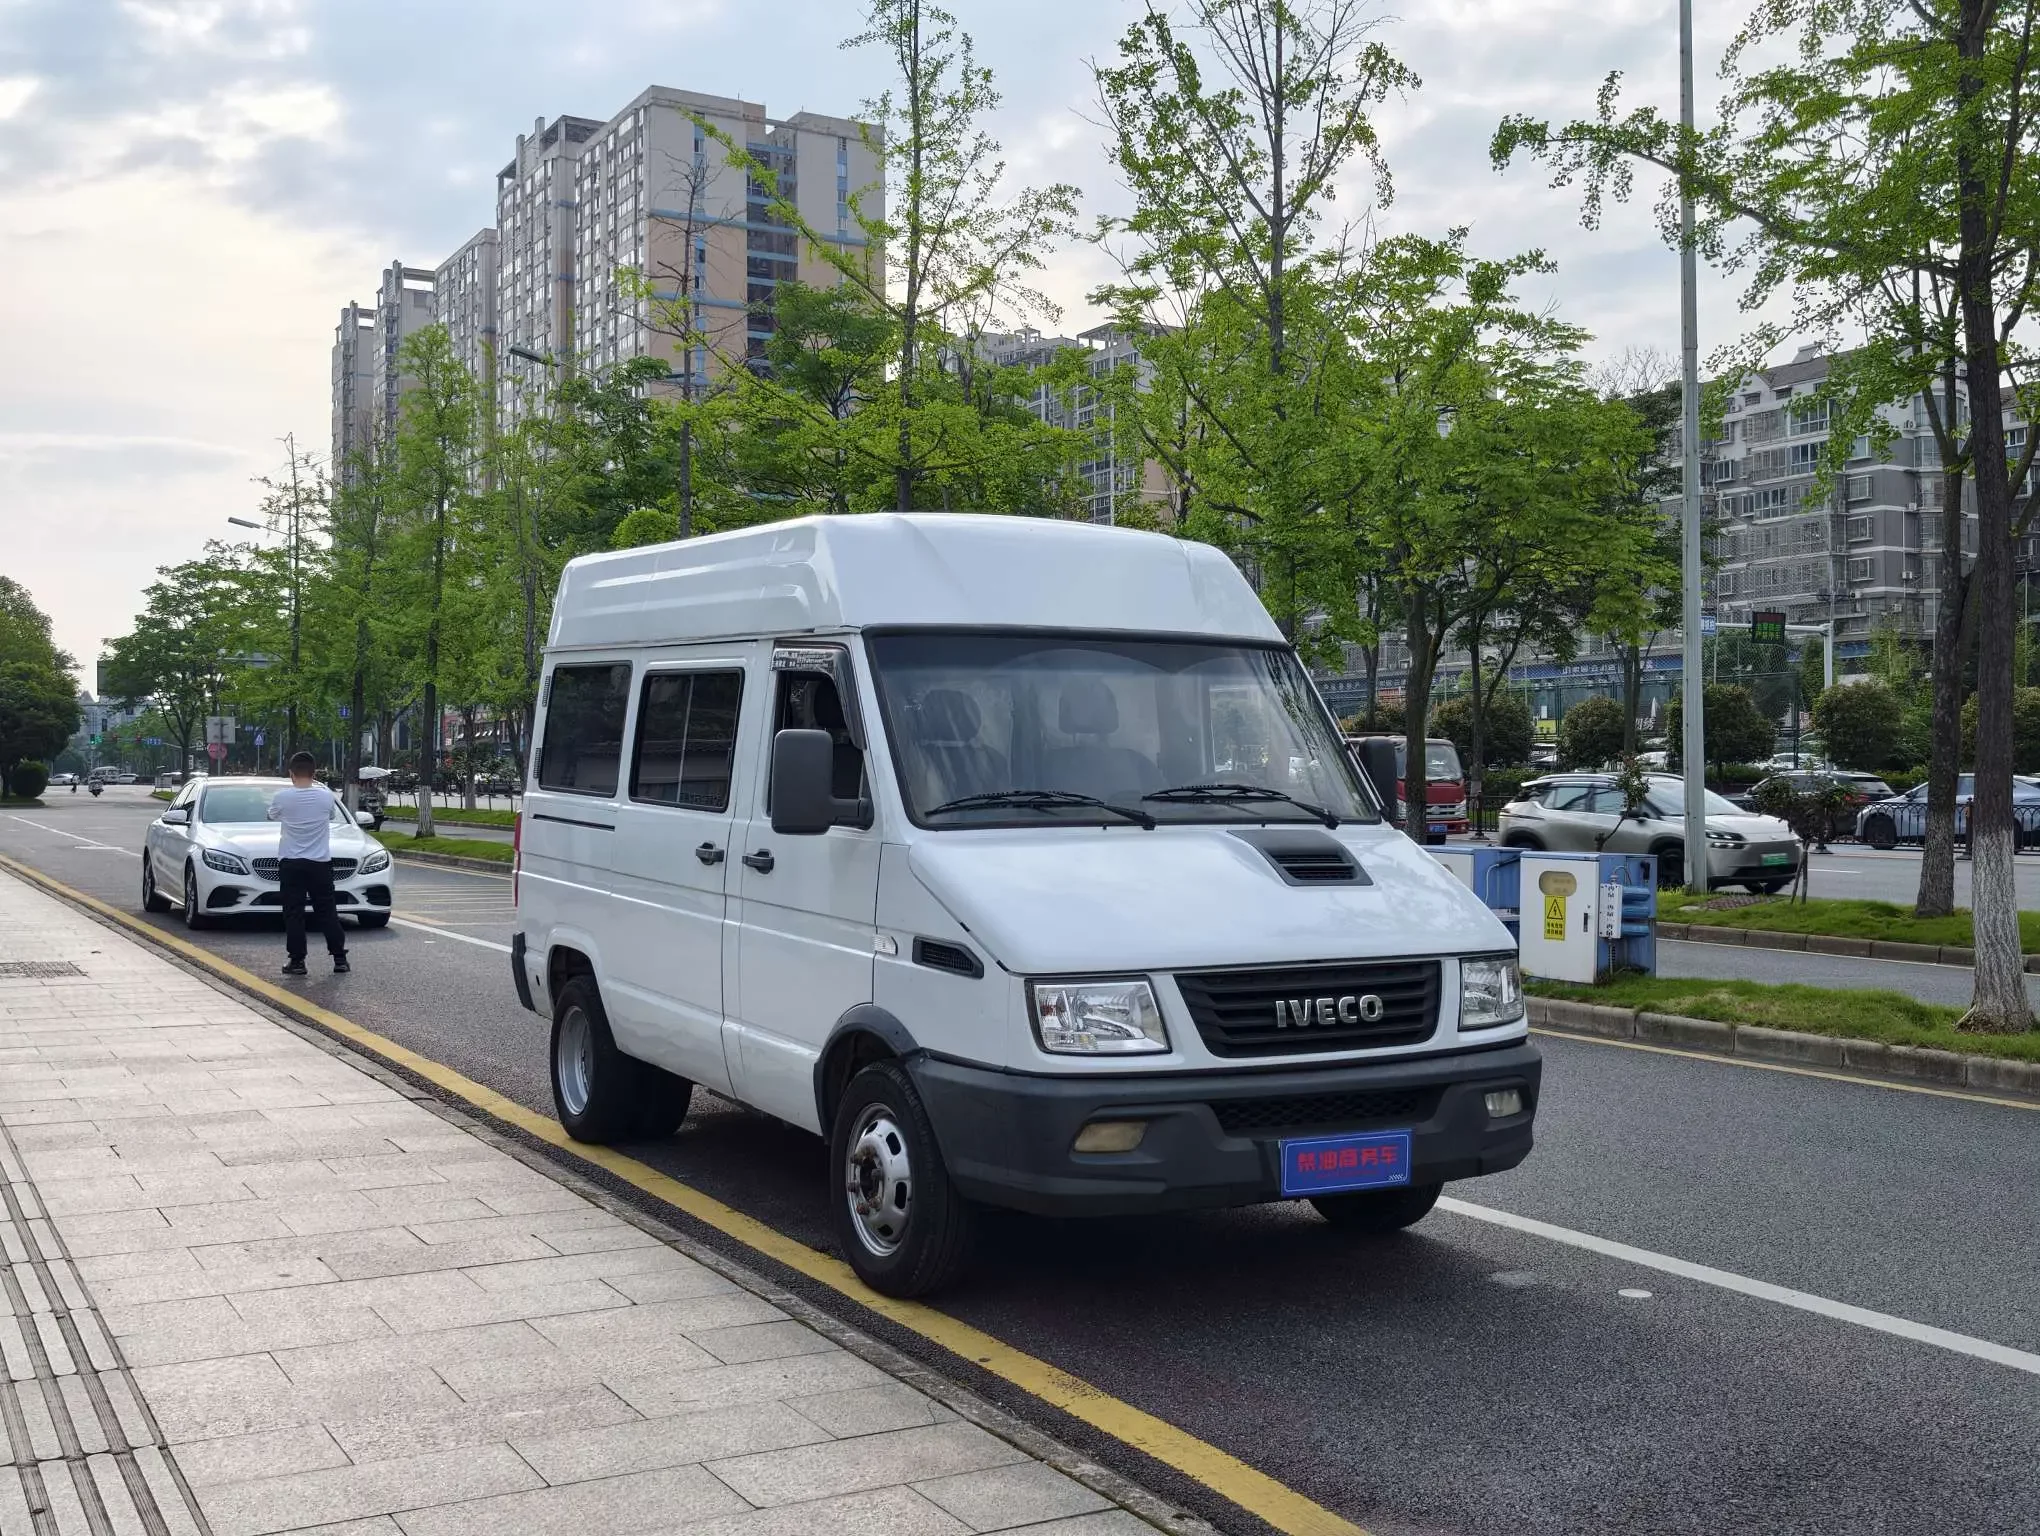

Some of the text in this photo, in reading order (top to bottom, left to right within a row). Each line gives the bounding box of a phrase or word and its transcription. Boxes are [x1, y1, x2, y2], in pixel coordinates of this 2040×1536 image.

[1275, 994, 1383, 1028] IVECO
[1296, 1145, 1399, 1173] 柴油商务车
